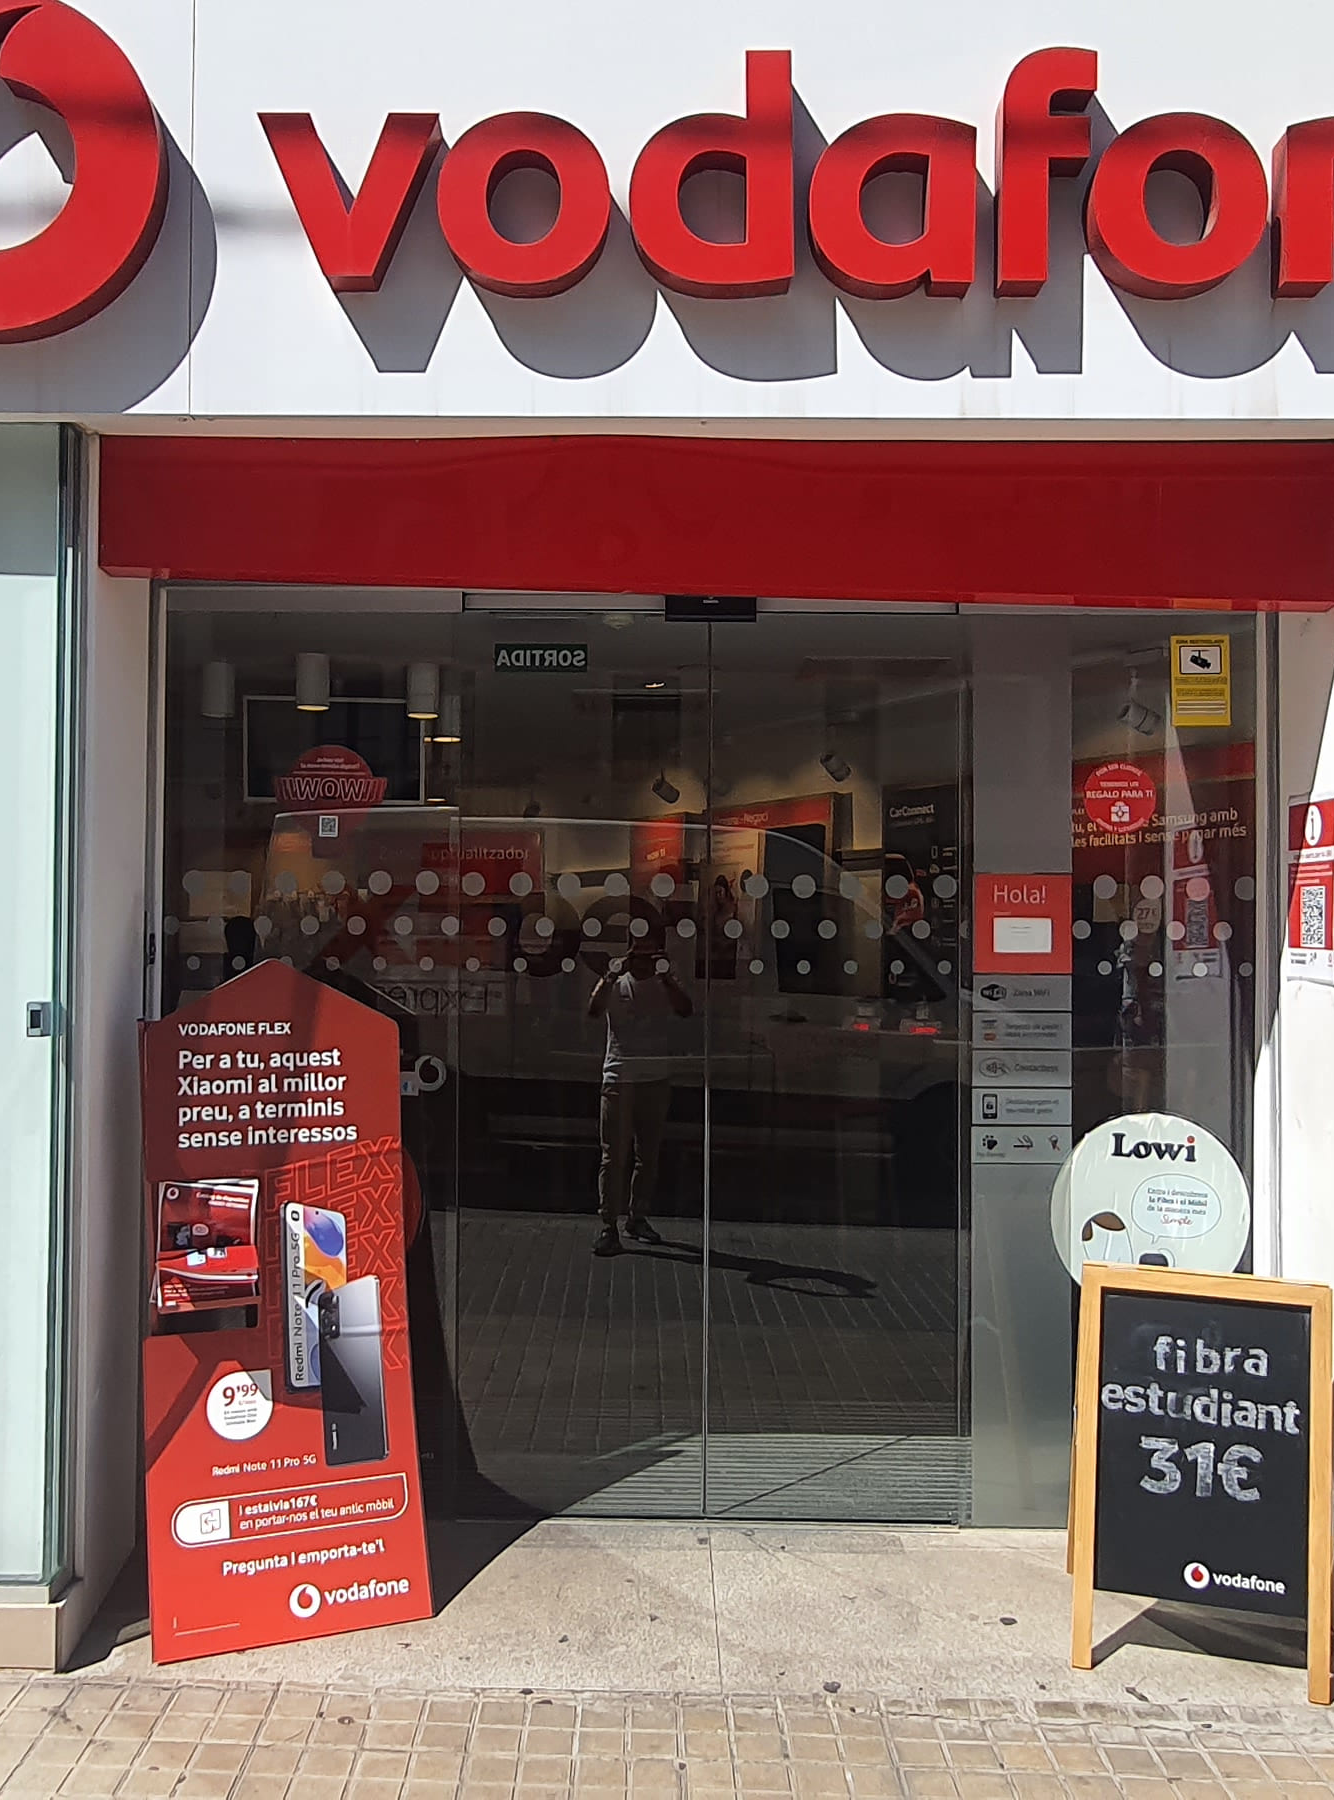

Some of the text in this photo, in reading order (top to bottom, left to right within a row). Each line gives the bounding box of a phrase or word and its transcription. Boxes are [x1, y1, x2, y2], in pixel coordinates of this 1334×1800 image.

[1086, 789, 1154, 799] REGALO PARA TI
[1152, 811, 1207, 828] Samsung
[1210, 807, 1238, 822] amb
[1090, 832, 1136, 847] facilitats
[1219, 824, 1247, 837] més
[993, 885, 1046, 904] Hola!
[178, 1022, 291, 1036] VODAFONE FLEX
[178, 1048, 341, 1071] Per a tu, aquest
[177, 1072, 347, 1096] Xiaomi al millor
[178, 1097, 345, 1127] preu, a terminis
[178, 1125, 357, 1148] sense interessos
[1112, 1133, 1196, 1162] Lowi
[291, 1232, 301, 1250] 5G
[292, 1256, 302, 1277] Pro
[293, 1304, 303, 1337] Note
[295, 1342, 304, 1381] Redmi
[1153, 1335, 1269, 1377] fibra
[1101, 1382, 1301, 1435] estudiant
[212, 1454, 317, 1476] Redmi Note 11 Pro 5G
[1139, 1435, 1264, 1502] 31€
[239, 1497, 394, 1531] en portar-nos el teu antic mòbil
[223, 1555, 288, 1576] Pregunta
[298, 1539, 385, 1565] emporta-te'l
[324, 1578, 409, 1605] vodafone
[1212, 1572, 1287, 1594] vodafone
